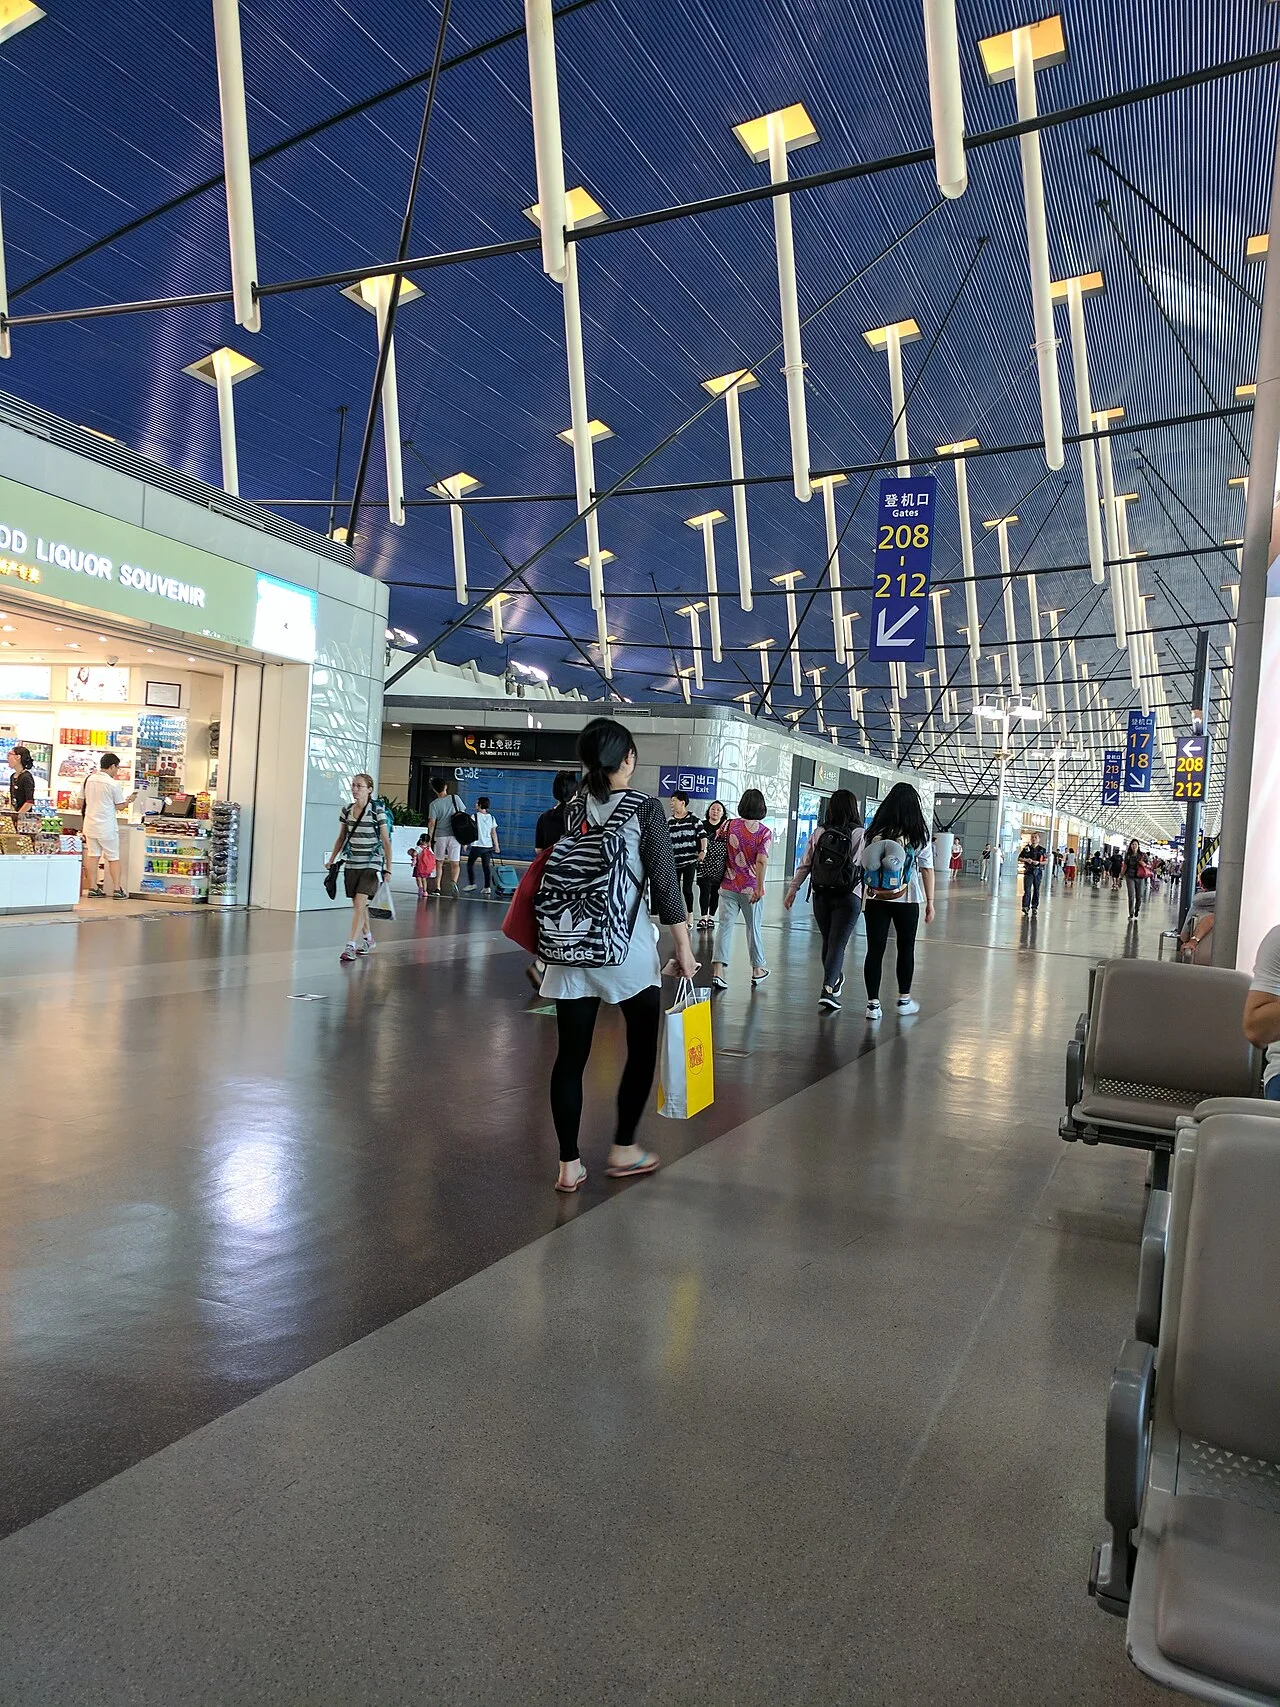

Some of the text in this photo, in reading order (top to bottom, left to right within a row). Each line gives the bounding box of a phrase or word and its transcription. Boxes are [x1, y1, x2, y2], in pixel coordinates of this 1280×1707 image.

[885, 493, 929, 507] 登机口
[892, 509, 919, 518] Gates
[878, 524, 929, 550] 208
[36, 537, 112, 581] LIQUOR
[119, 564, 206, 608] SOUVENIR
[875, 573, 926, 598] 212
[1131, 718, 1153, 726] 登机口
[1130, 733, 1150, 748] 17
[1129, 753, 1149, 768] 18
[1177, 757, 1204, 772] 208
[1106, 765, 1119, 774] 213
[696, 774, 716, 786] 出口
[1105, 780, 1118, 789] 216
[1175, 782, 1202, 797] 212
[544, 947, 595, 961] adidas
